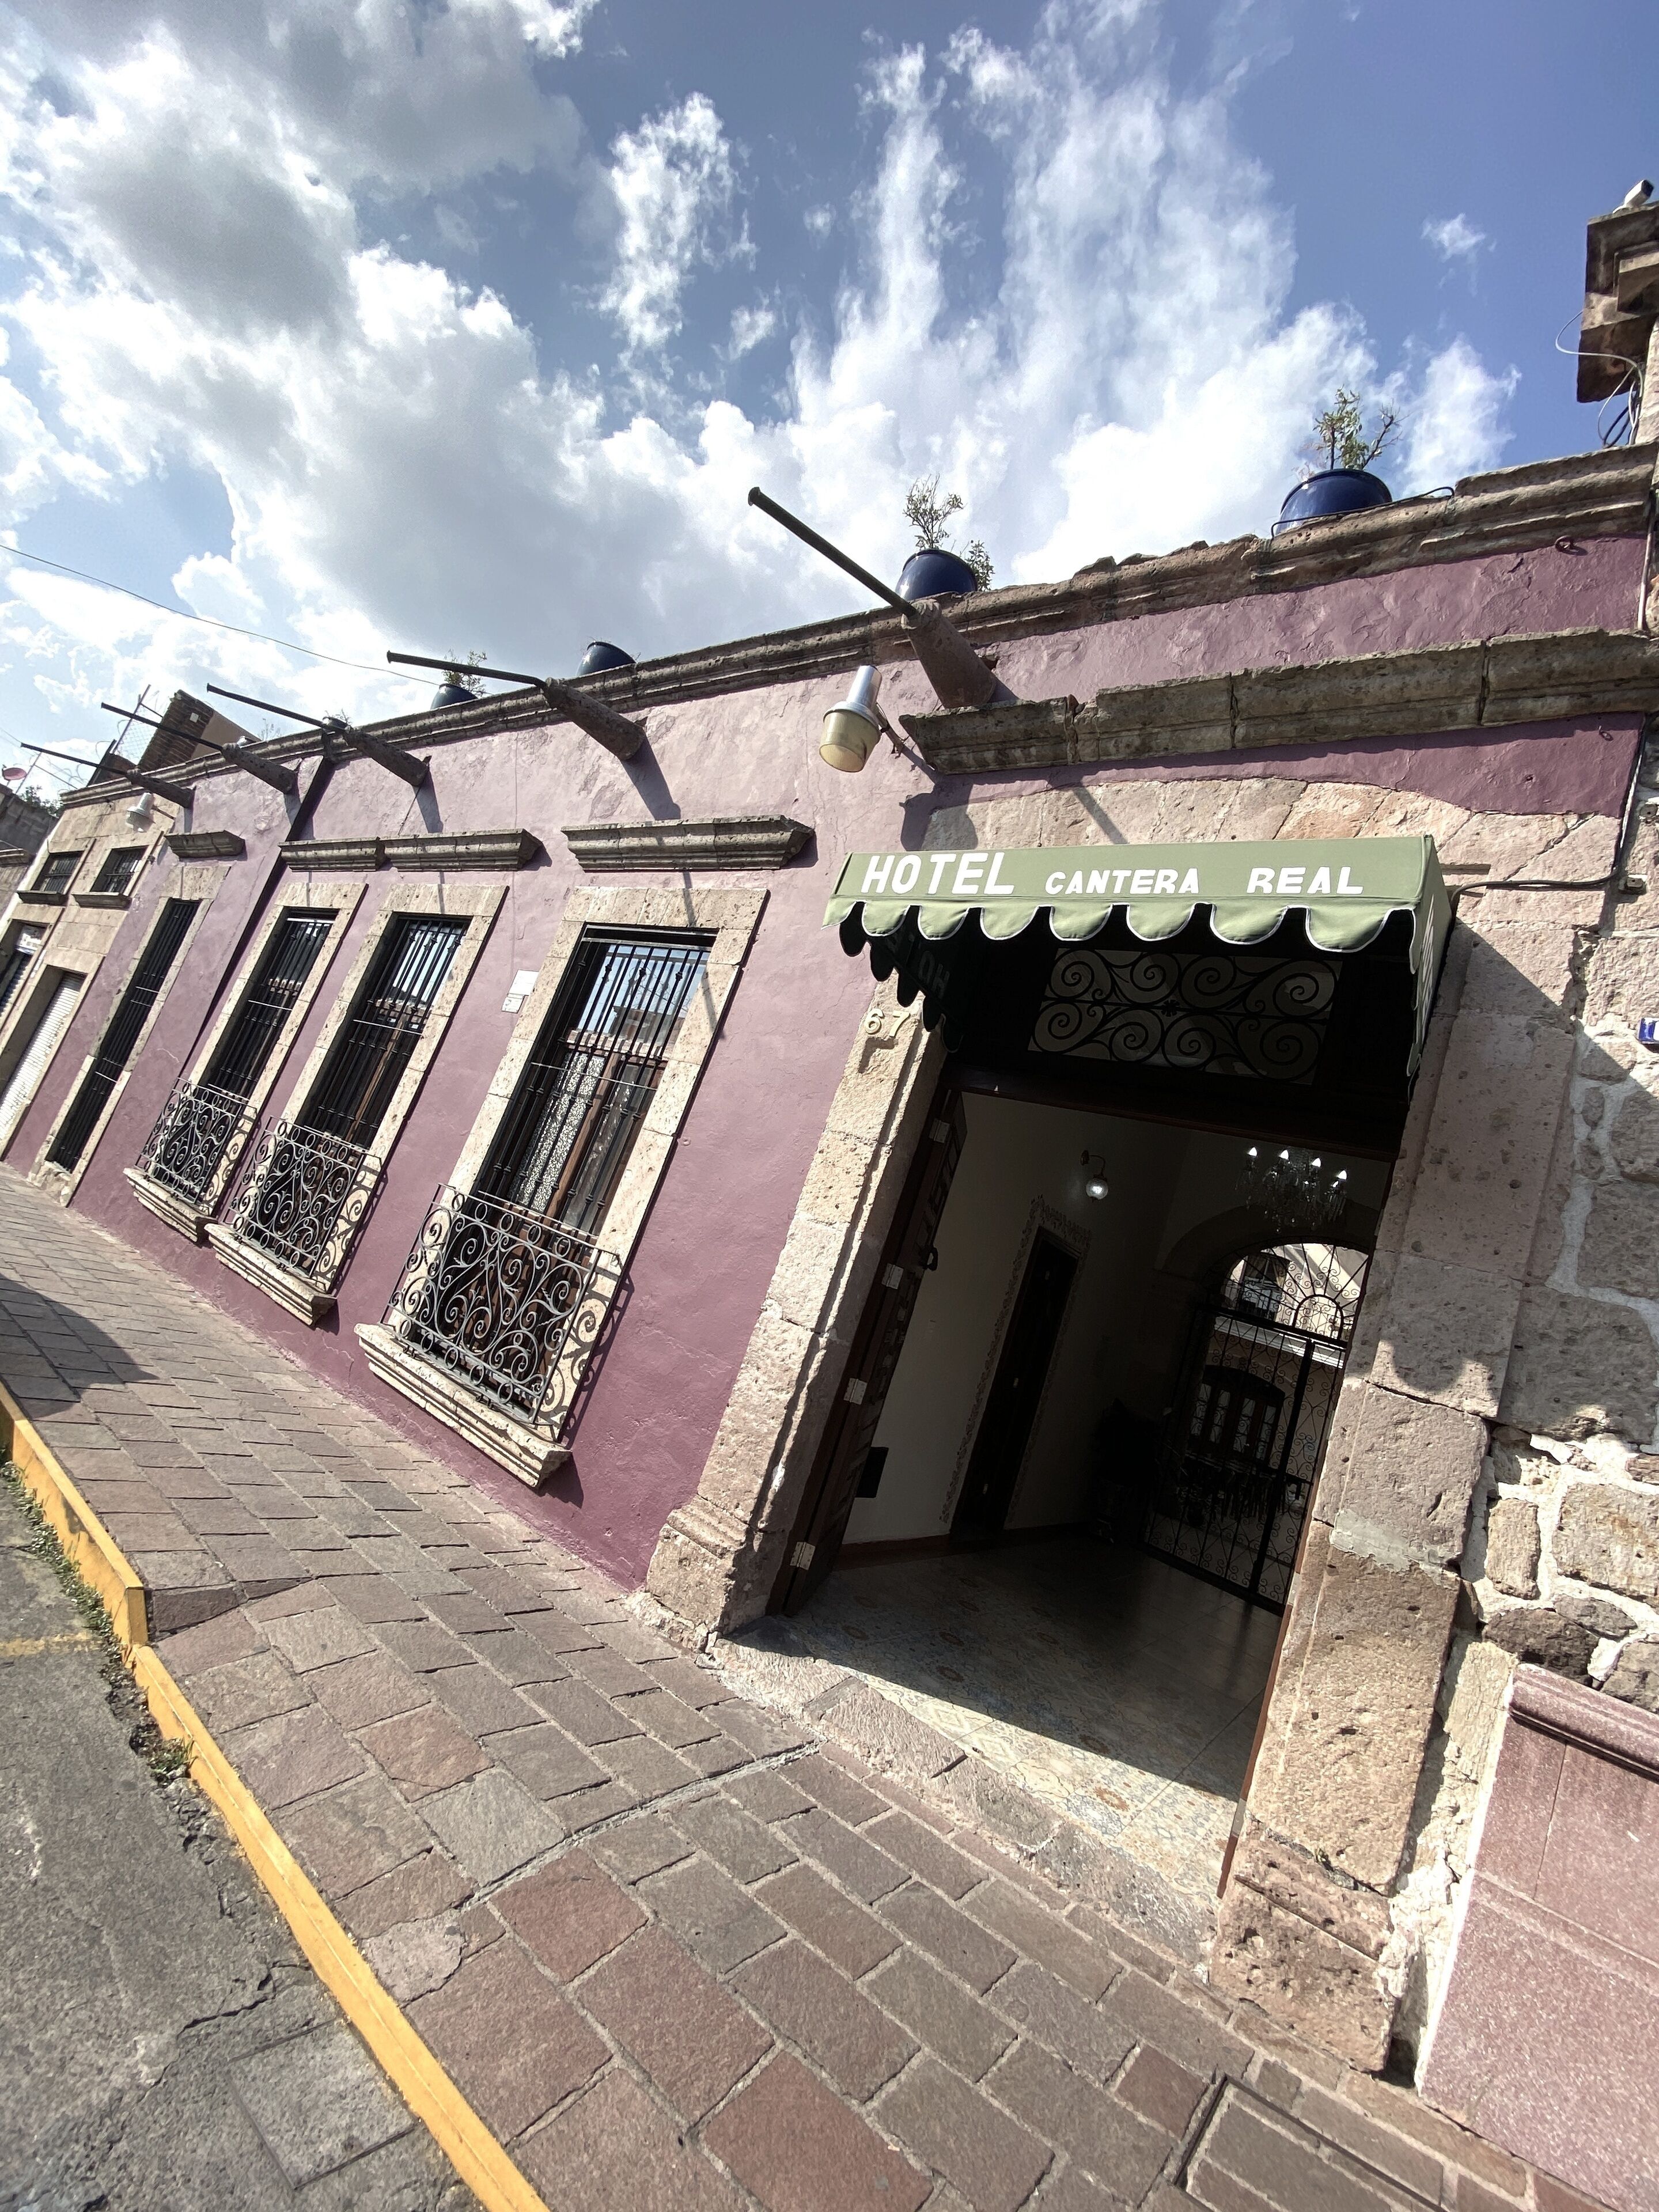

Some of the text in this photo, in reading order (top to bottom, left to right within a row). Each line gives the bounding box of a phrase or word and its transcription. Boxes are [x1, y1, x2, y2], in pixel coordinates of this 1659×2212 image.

[861, 852, 1363, 895] HOTEL CANTERA REAL
[864, 1008, 910, 1037] 67
